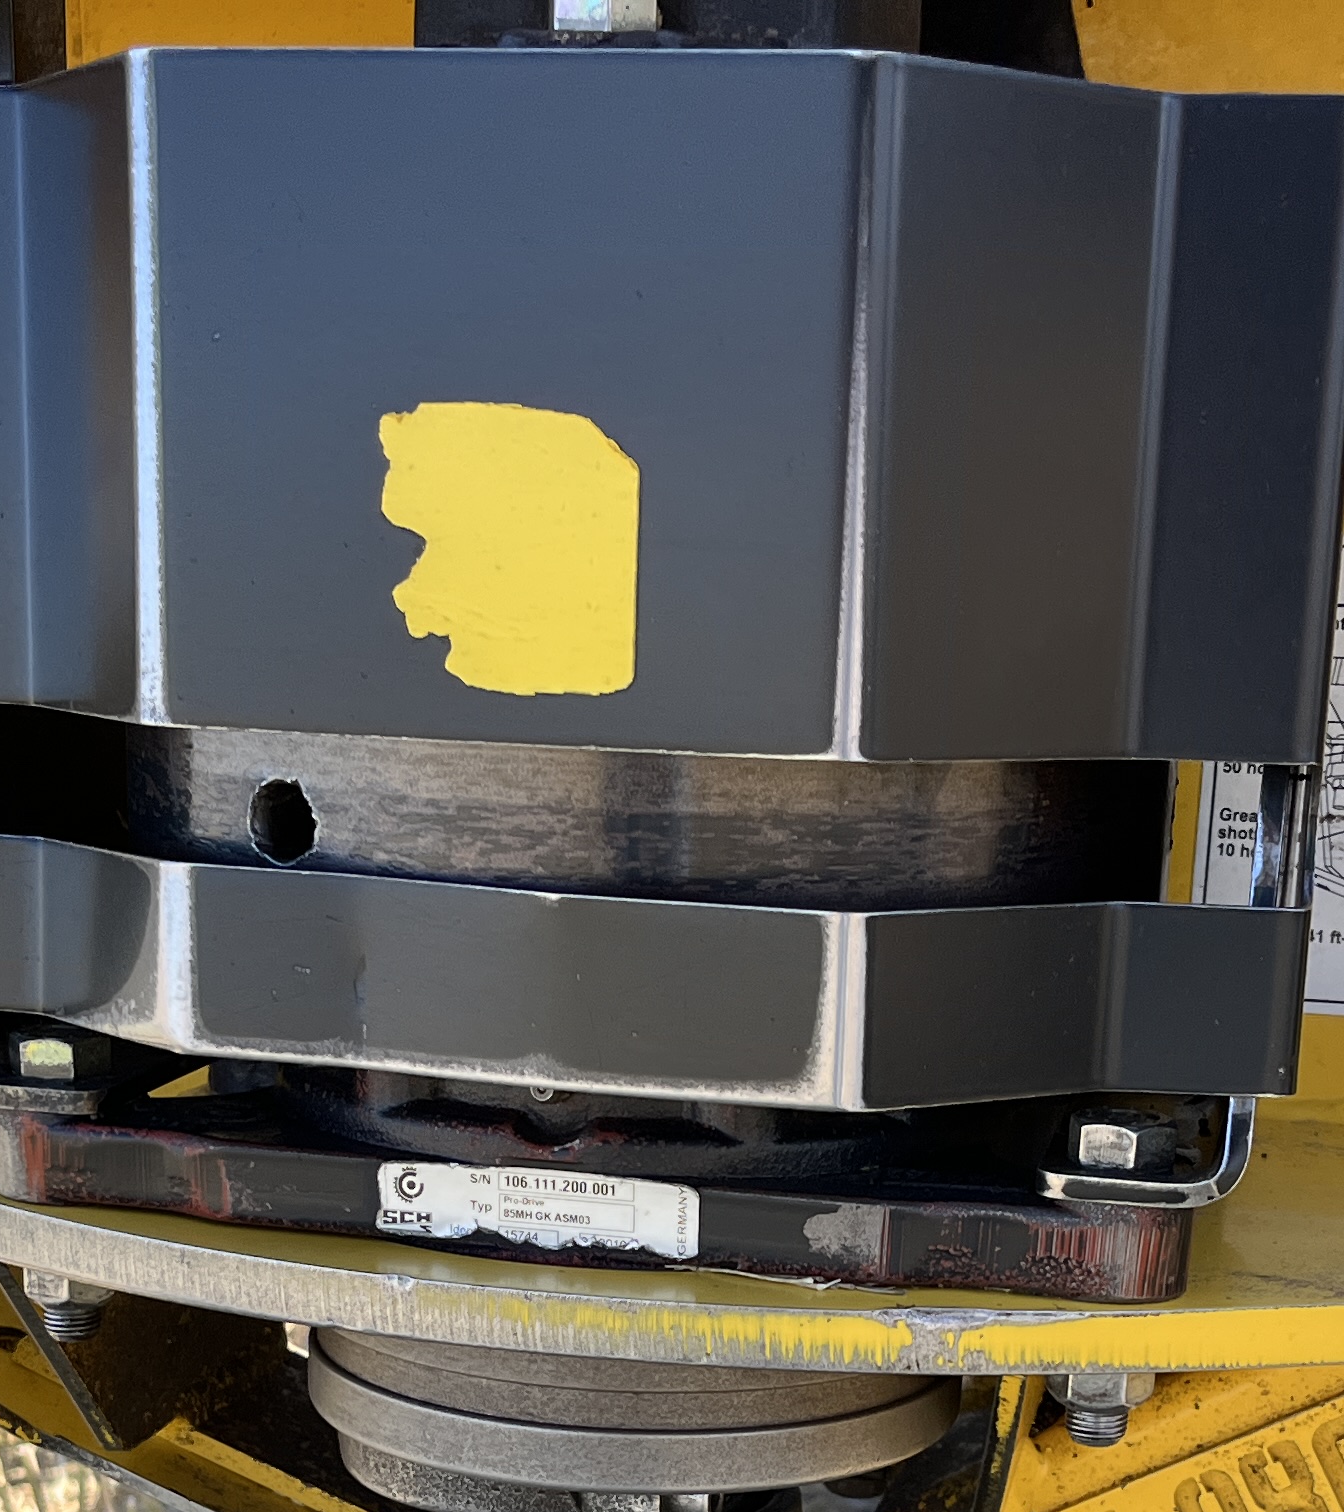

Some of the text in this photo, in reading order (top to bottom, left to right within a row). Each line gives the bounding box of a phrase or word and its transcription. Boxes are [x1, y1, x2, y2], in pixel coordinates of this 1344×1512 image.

[1216, 842, 1254, 858] 10 h
[470, 1173, 616, 1196] S/N 106.111.200.001
[470, 1199, 492, 1213] Typ
[504, 1196, 545, 1206] Pro-Drive
[503, 1208, 591, 1225] 85MH GK ASM03
[676, 1186, 688, 1256] GERMANY
